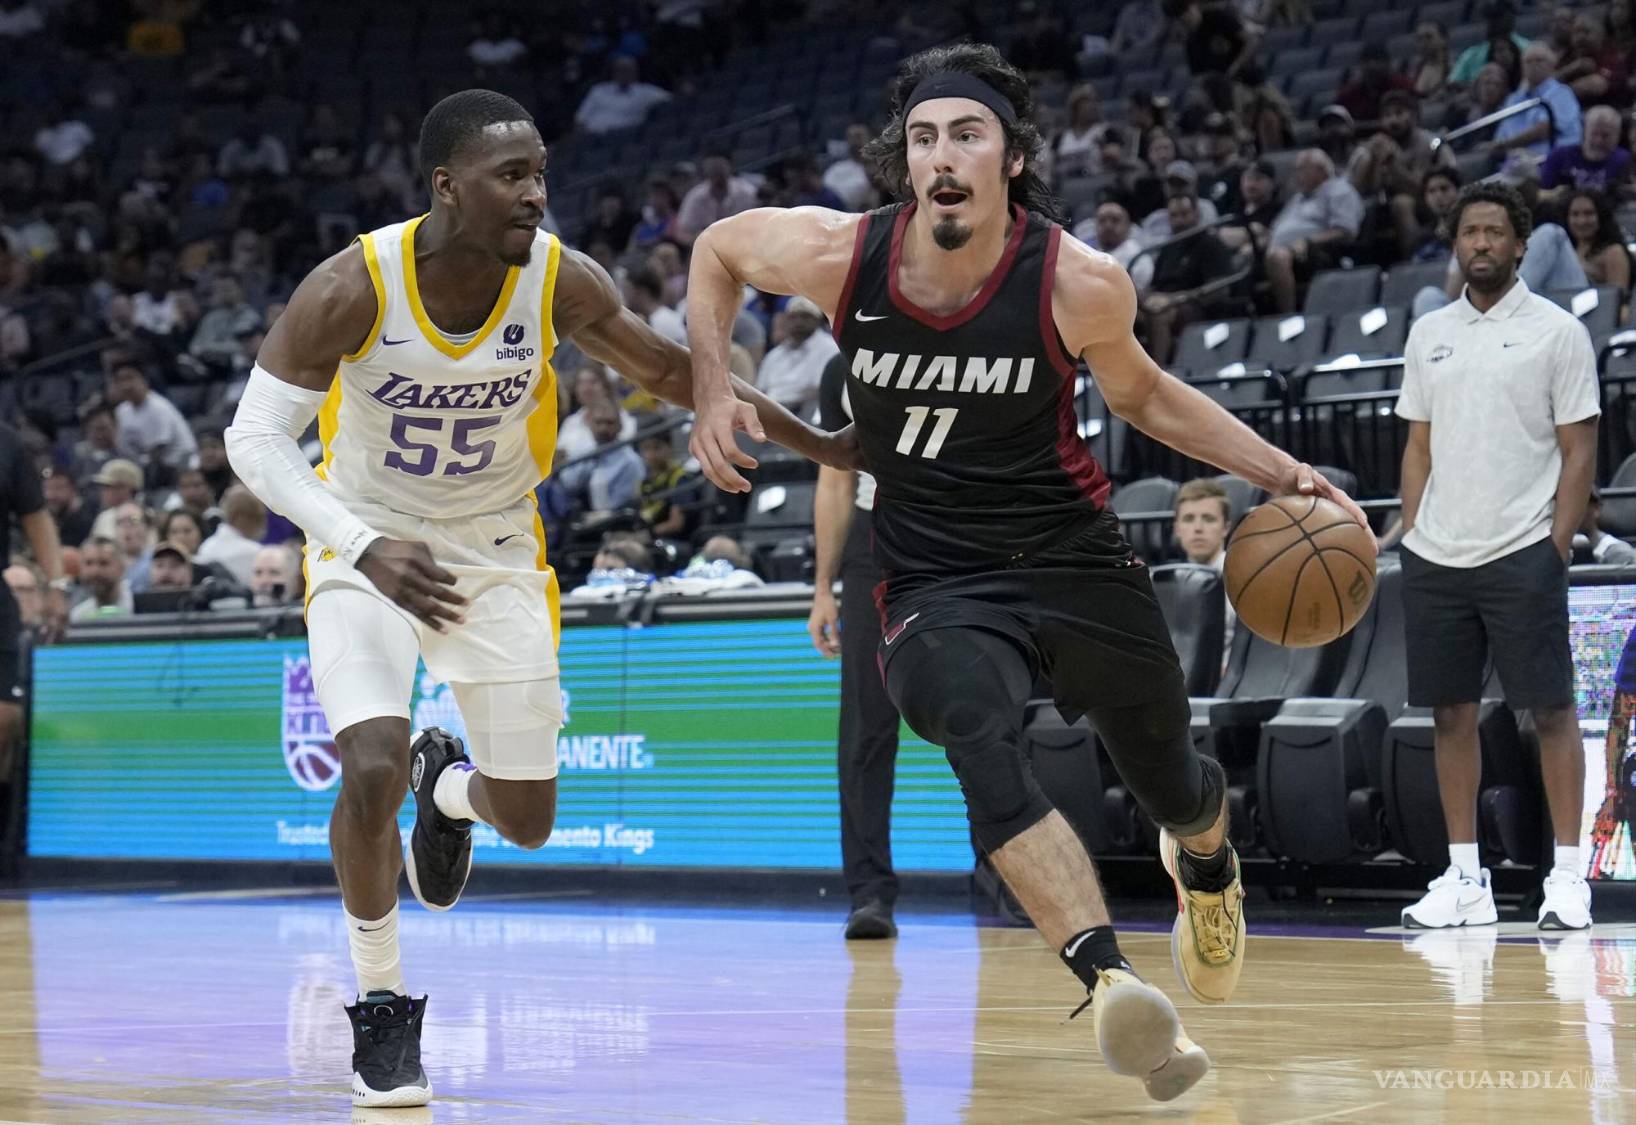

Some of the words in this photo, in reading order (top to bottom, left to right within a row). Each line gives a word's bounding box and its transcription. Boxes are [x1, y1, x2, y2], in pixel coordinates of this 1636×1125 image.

[496, 346, 534, 361] bibigo
[851, 347, 1036, 394] MIAMI
[365, 368, 533, 410] LAKERS
[383, 412, 503, 477] 55
[895, 405, 960, 460] 11
[557, 734, 646, 769] ANENTE
[603, 823, 655, 854] Kings
